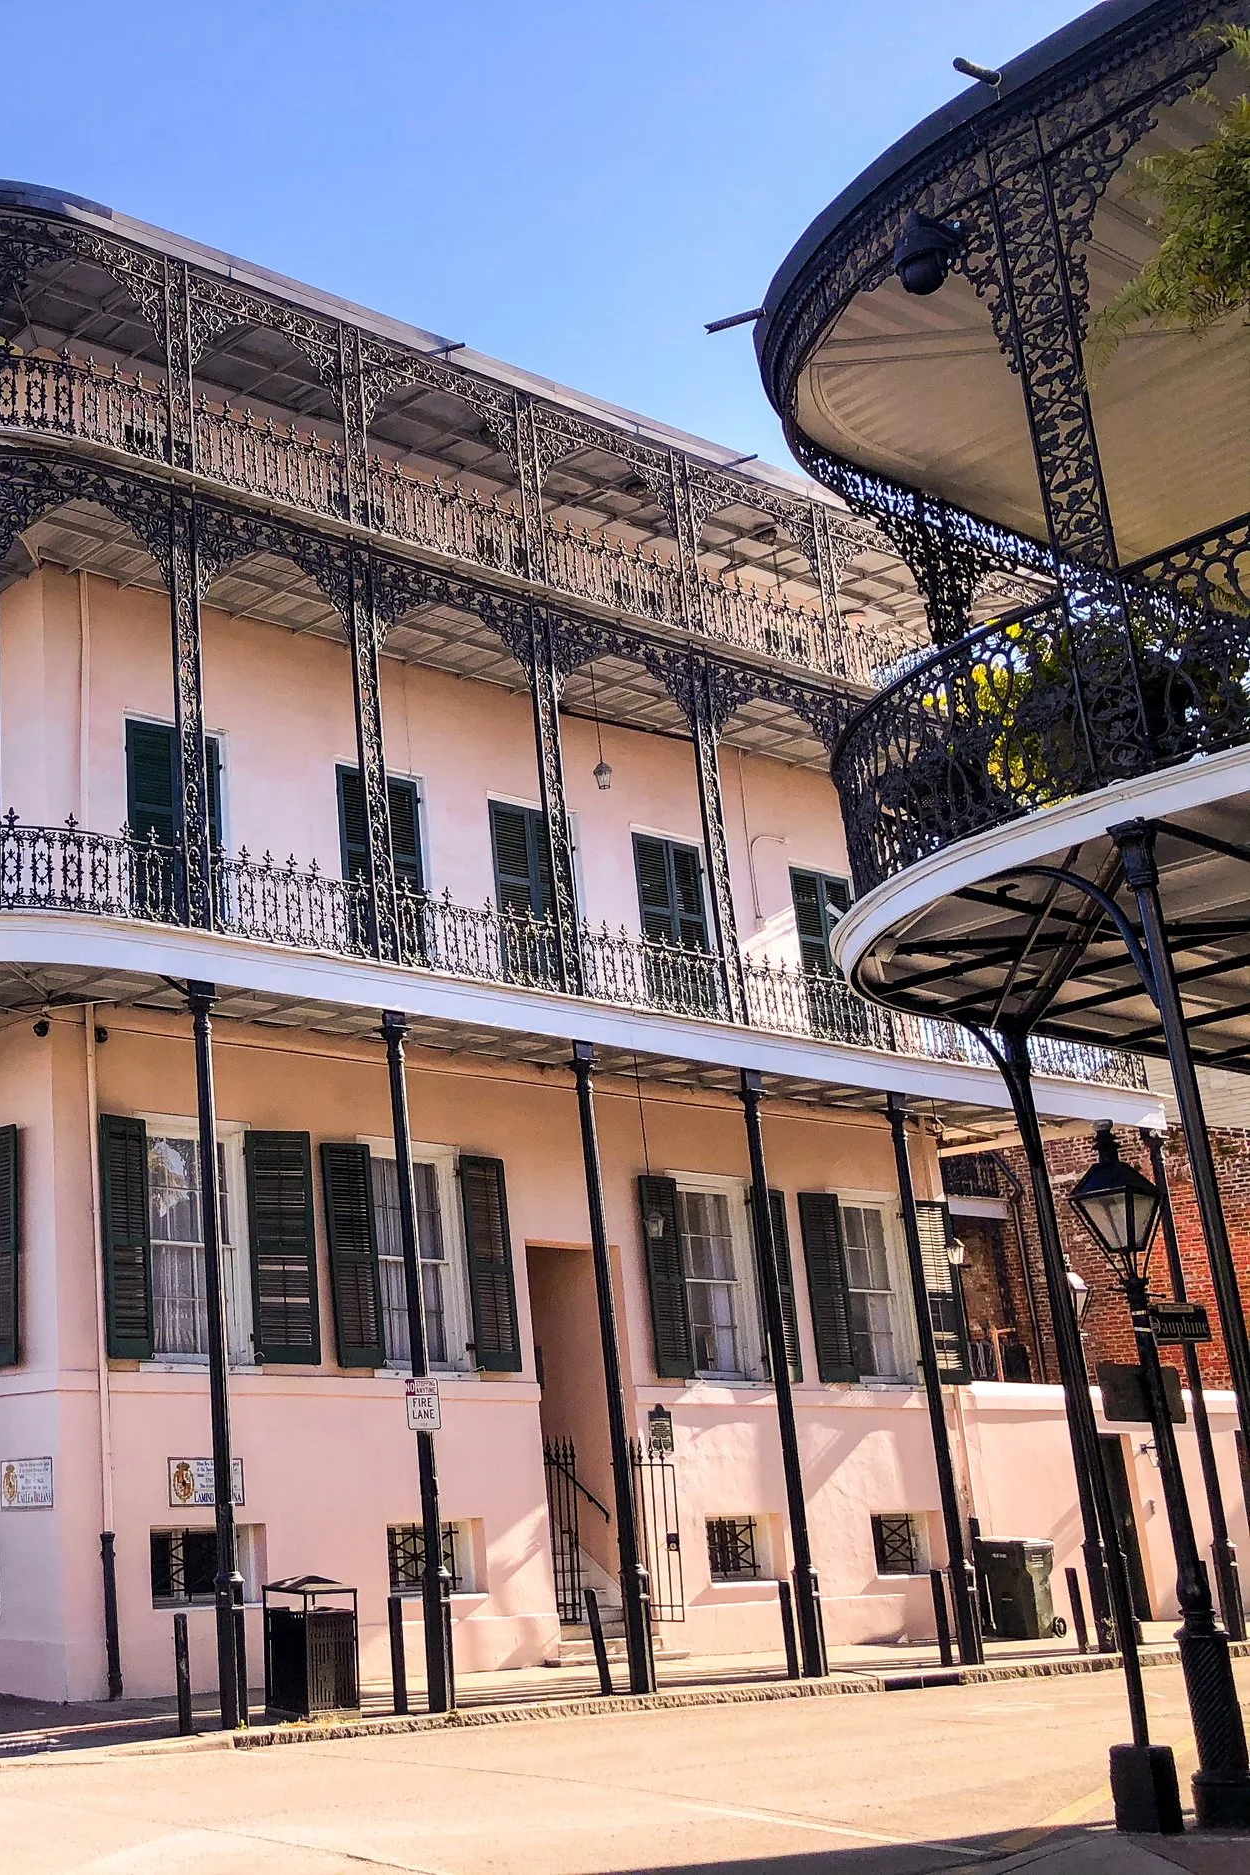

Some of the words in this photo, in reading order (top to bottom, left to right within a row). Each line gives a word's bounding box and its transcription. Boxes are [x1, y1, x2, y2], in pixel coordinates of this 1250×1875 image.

[1150, 1316, 1209, 1338] Dauphine
[405, 1382, 415, 1393] NO
[412, 1397, 433, 1408] FIRE
[412, 1409, 435, 1420] LANE
[194, 1491, 214, 1503] CAMINO
